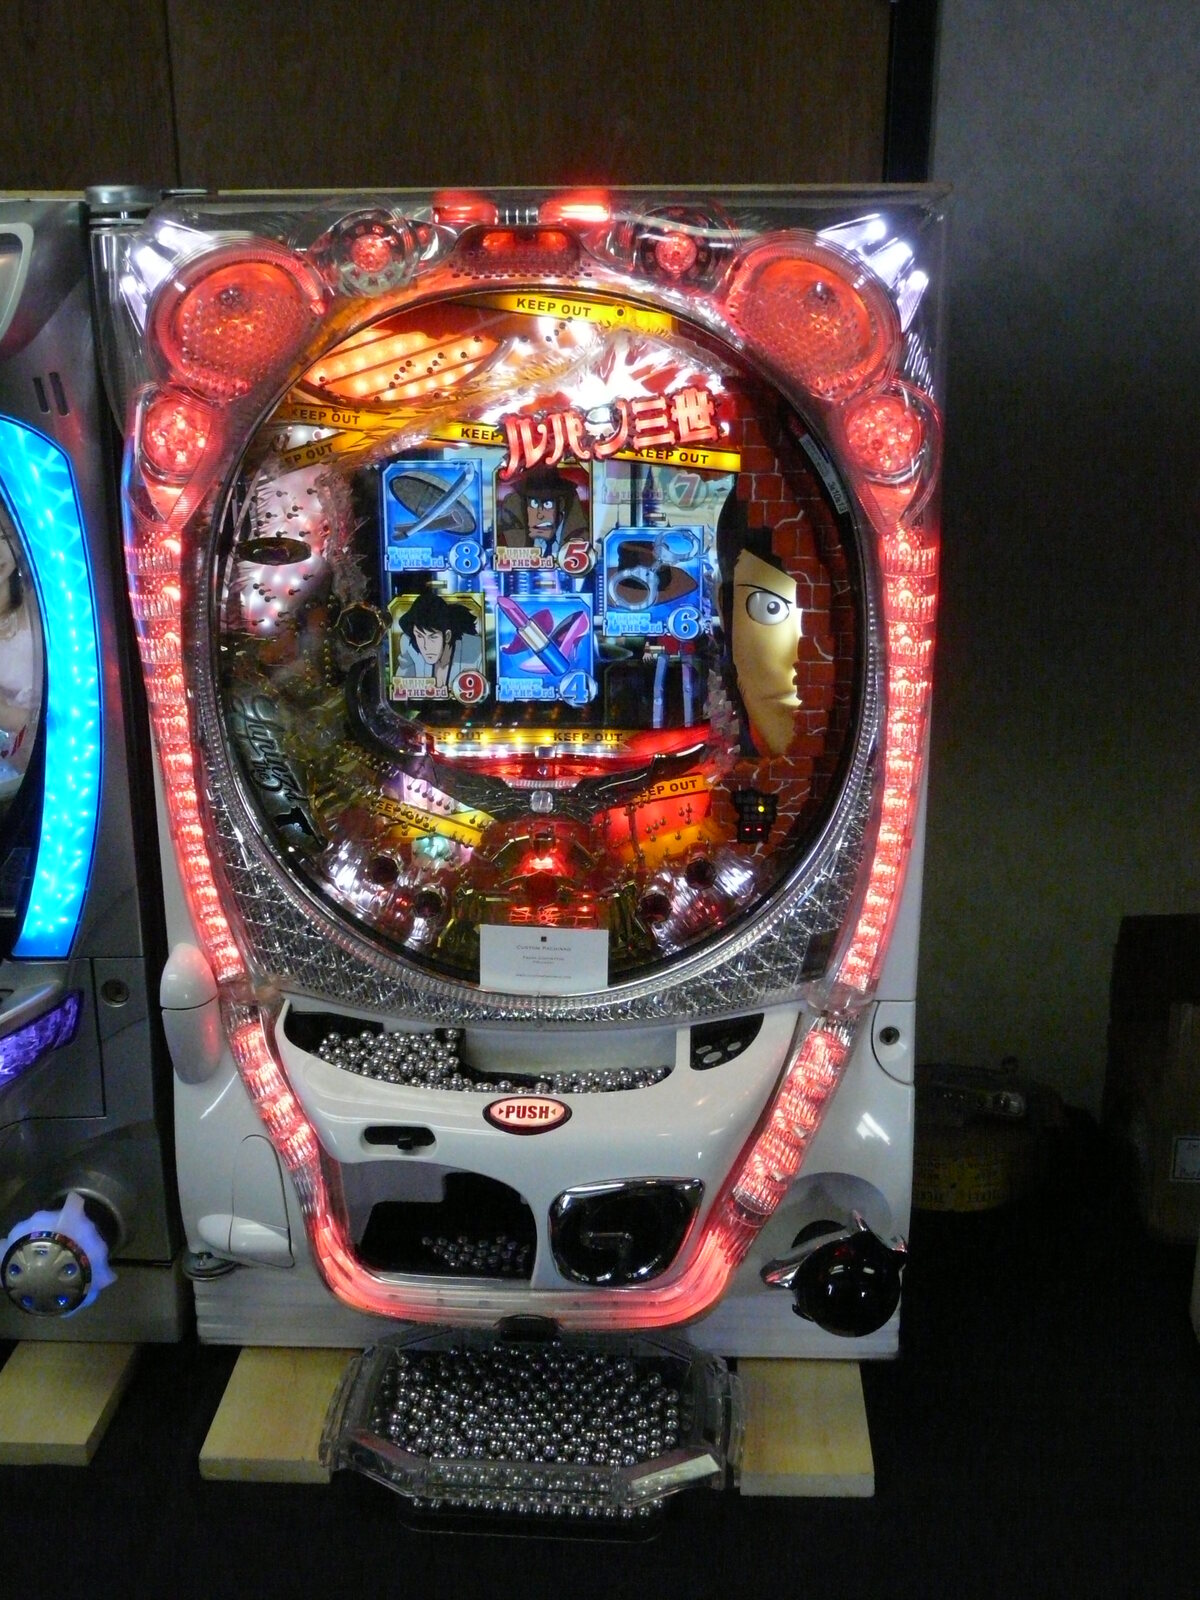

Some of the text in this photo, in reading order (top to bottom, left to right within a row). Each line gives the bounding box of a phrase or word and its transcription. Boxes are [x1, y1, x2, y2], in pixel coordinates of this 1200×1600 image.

[516, 297, 592, 318] KEEP OUT
[331, 413, 361, 425] OUT
[460, 427, 499, 441] KEEP
[306, 442, 333, 459] OUT
[634, 448, 710, 465] KEEP OUT
[673, 473, 701, 507] 7
[455, 541, 481, 574] 8
[512, 559, 530, 567] THE
[563, 541, 589, 574] 5
[673, 607, 699, 639] 6
[408, 689, 425, 697] THE
[458, 672, 484, 703] 9
[562, 672, 588, 704] 4
[553, 732, 623, 742] KEEP OUT
[669, 780, 697, 792] OUT
[505, 1105, 549, 1119] PUSH
